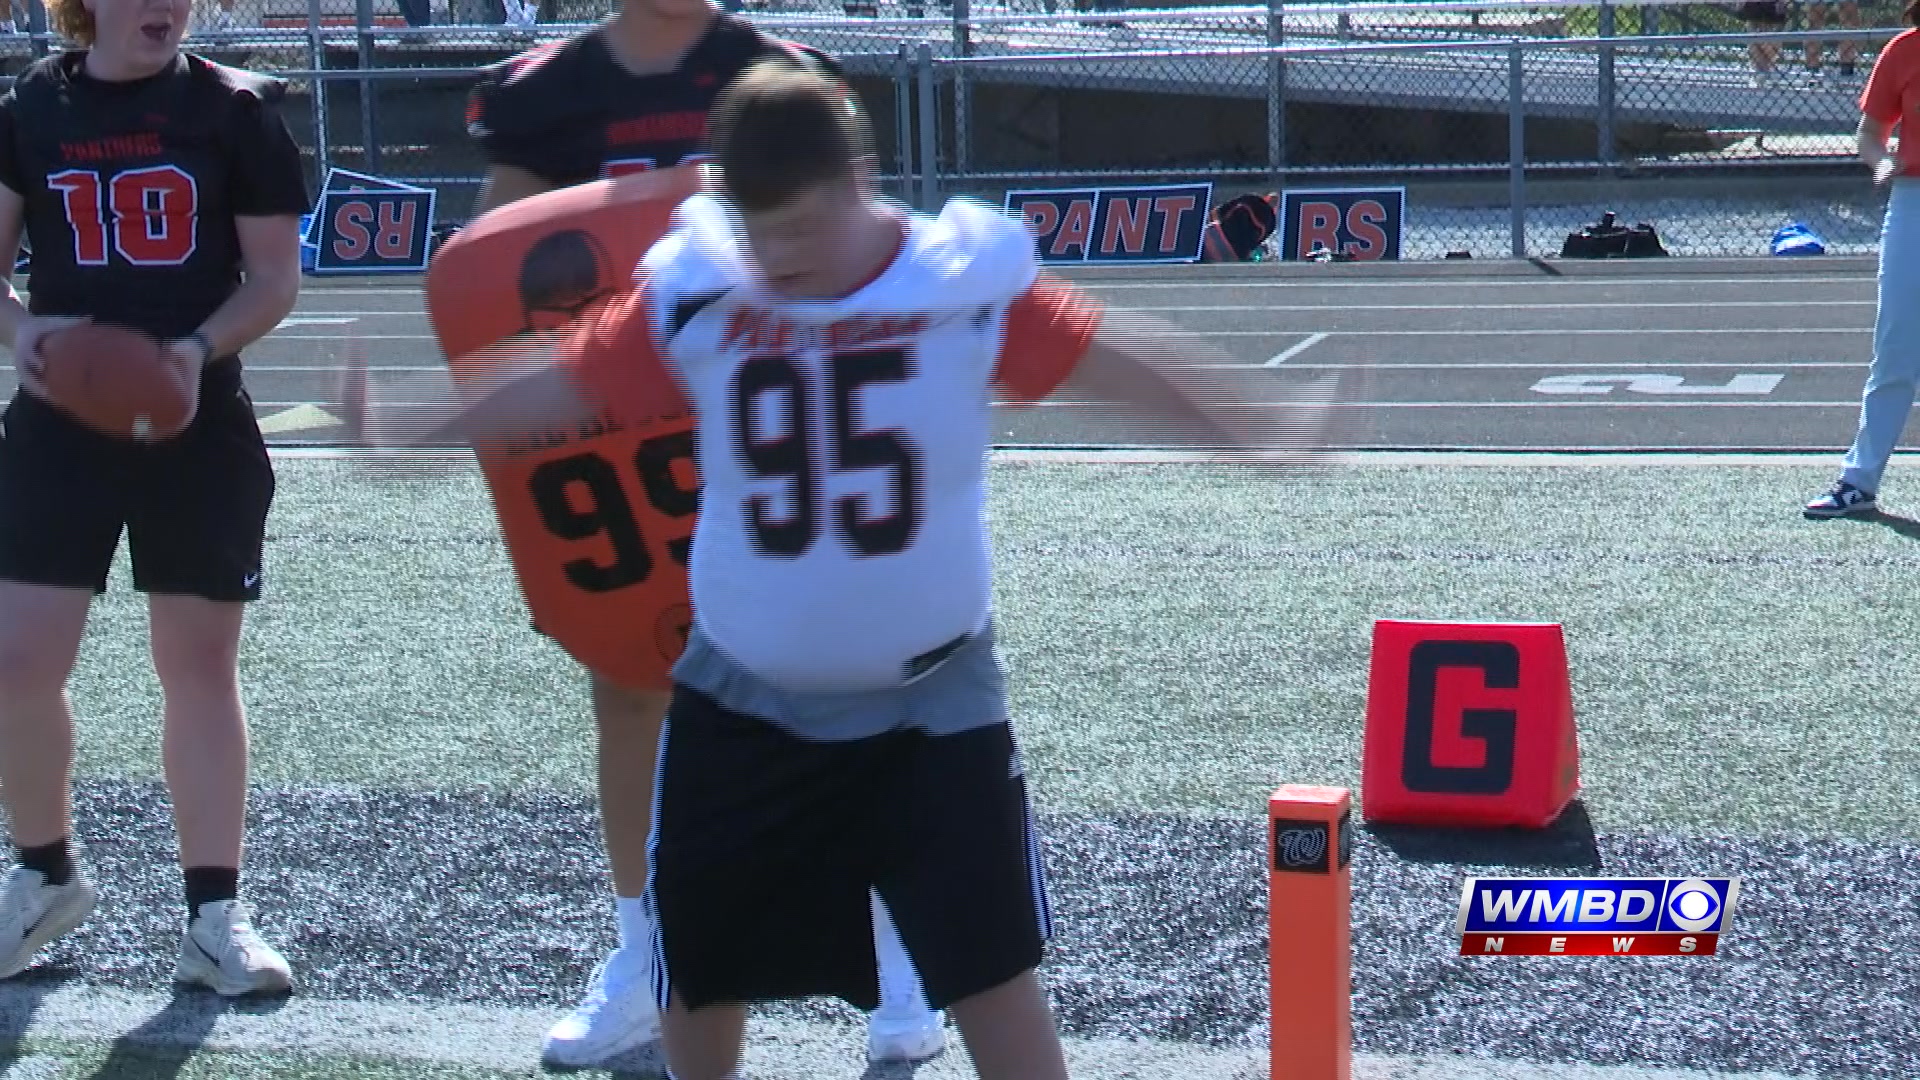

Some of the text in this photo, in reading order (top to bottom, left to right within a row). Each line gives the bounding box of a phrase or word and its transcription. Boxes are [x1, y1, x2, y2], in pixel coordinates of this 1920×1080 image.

[1297, 200, 1387, 260] RS
[728, 343, 925, 560] 95
[1402, 640, 1520, 795] G
